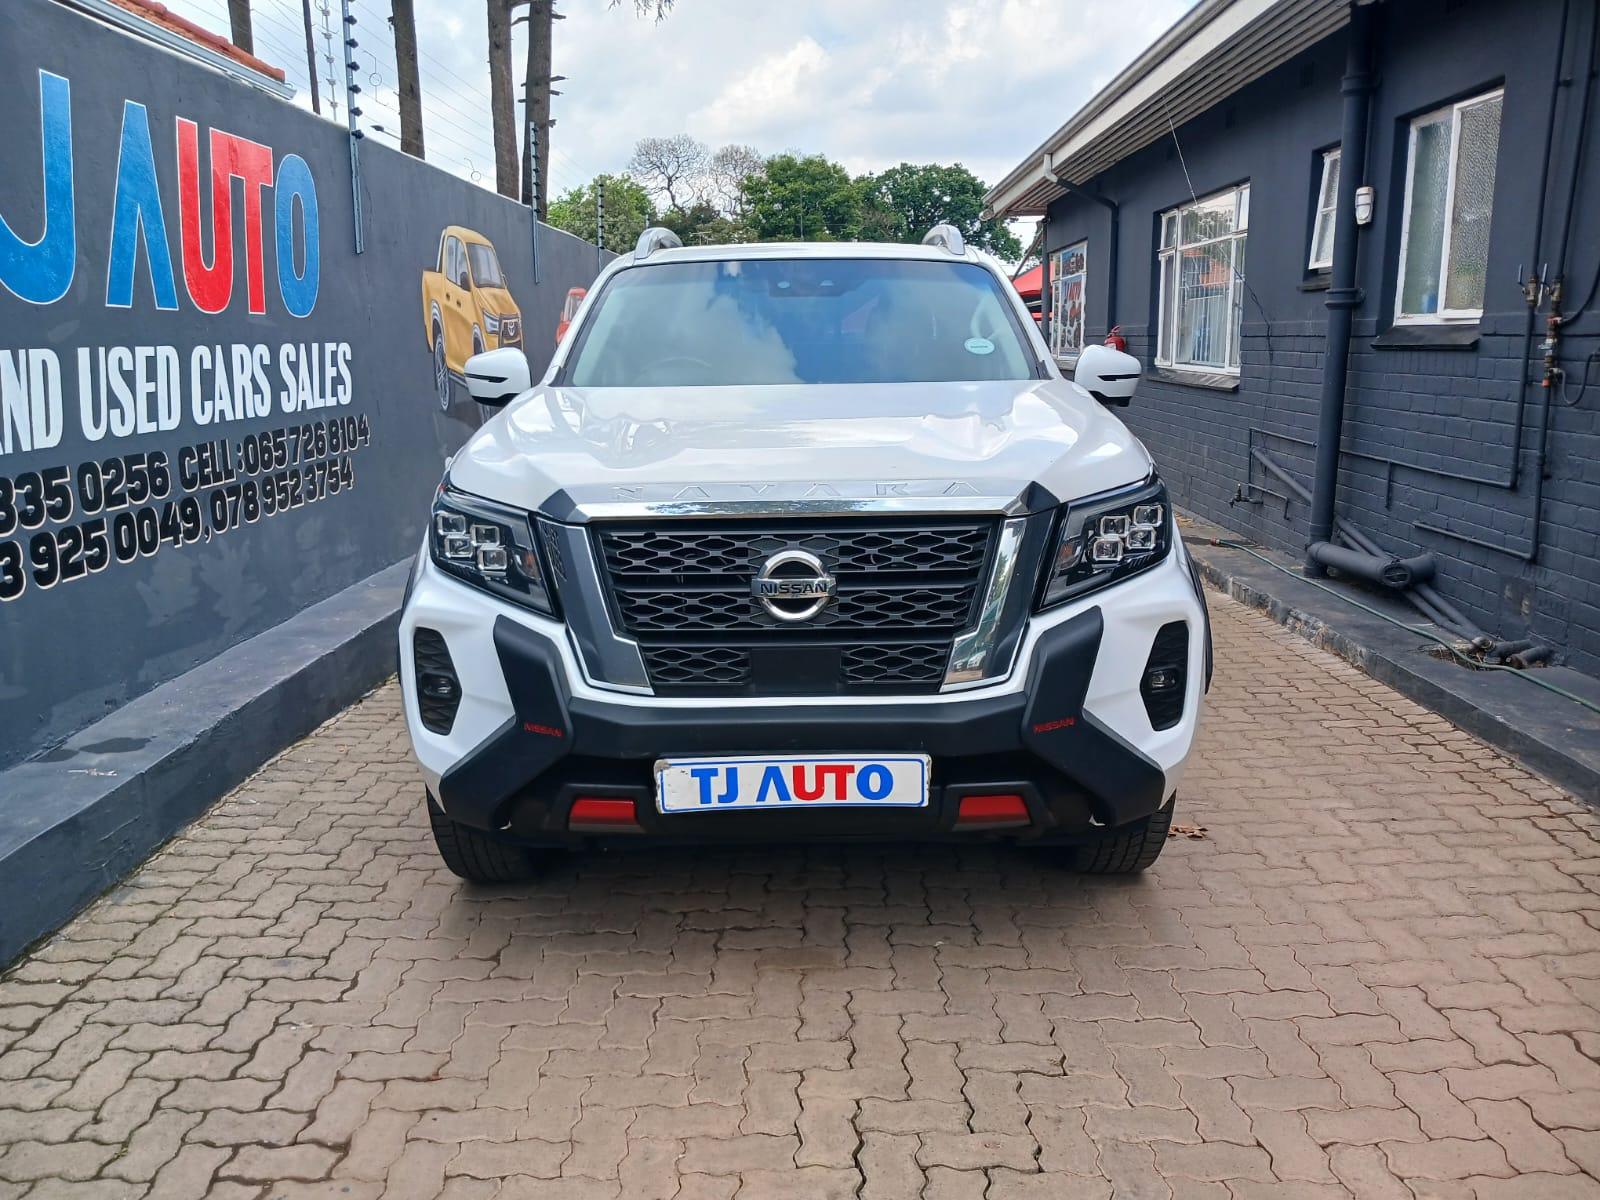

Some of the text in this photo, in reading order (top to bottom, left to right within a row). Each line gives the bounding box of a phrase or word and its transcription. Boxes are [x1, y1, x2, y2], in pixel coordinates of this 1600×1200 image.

[105, 99, 320, 318] AUTO
[0, 342, 352, 456] ND USED CARS SALES
[77, 451, 171, 515] 0256
[289, 421, 326, 465] 726
[328, 412, 371, 455] 8104
[30, 518, 110, 589] 925
[262, 468, 305, 517] 952
[304, 455, 354, 503] 3754
[760, 583, 828, 594] NISSAN
[523, 722, 563, 738] NISSAN
[1033, 717, 1075, 733] NISSAN
[691, 763, 894, 804] TJ AUTO
